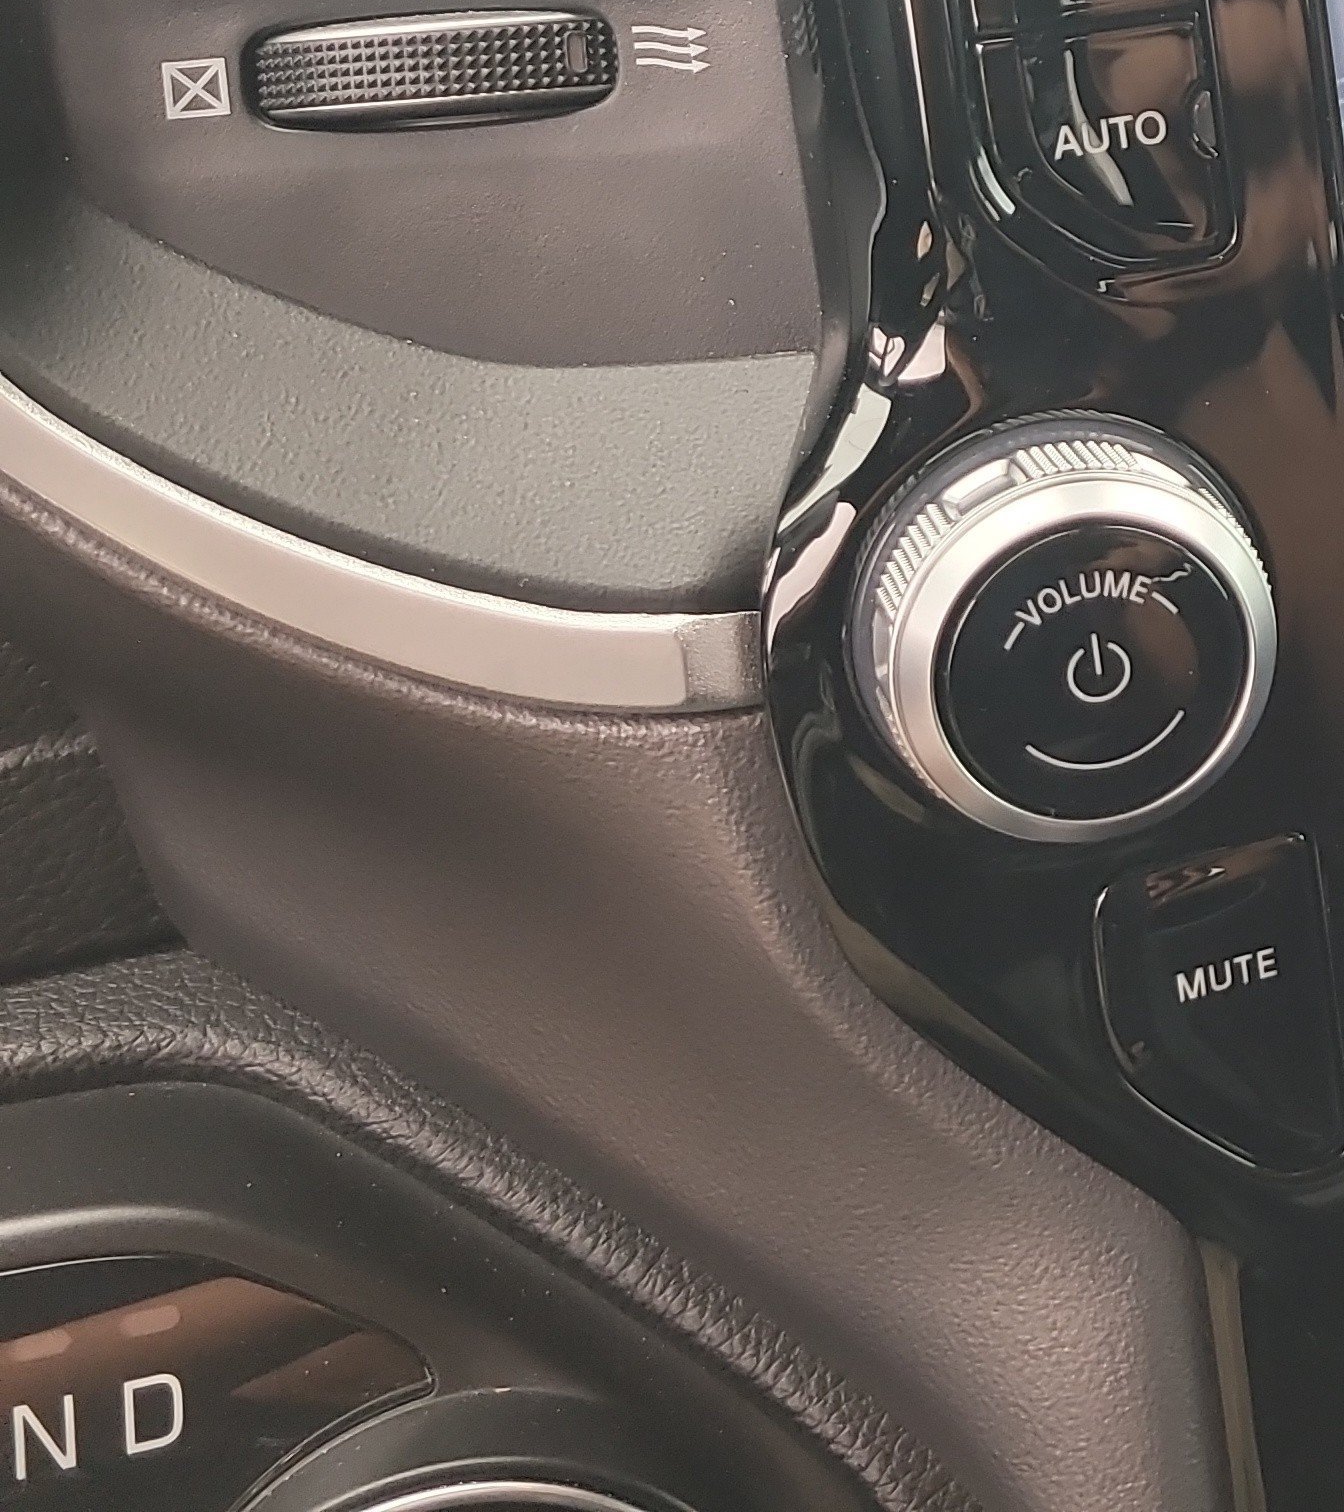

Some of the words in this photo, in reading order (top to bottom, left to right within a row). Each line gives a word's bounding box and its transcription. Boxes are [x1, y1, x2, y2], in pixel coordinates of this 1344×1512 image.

[1054, 110, 1167, 161] AUTO
[1015, 570, 1151, 629] VOLUME
[1176, 947, 1279, 1003] MUTE
[12, 1394, 77, 1481] N
[123, 1373, 184, 1455] D
